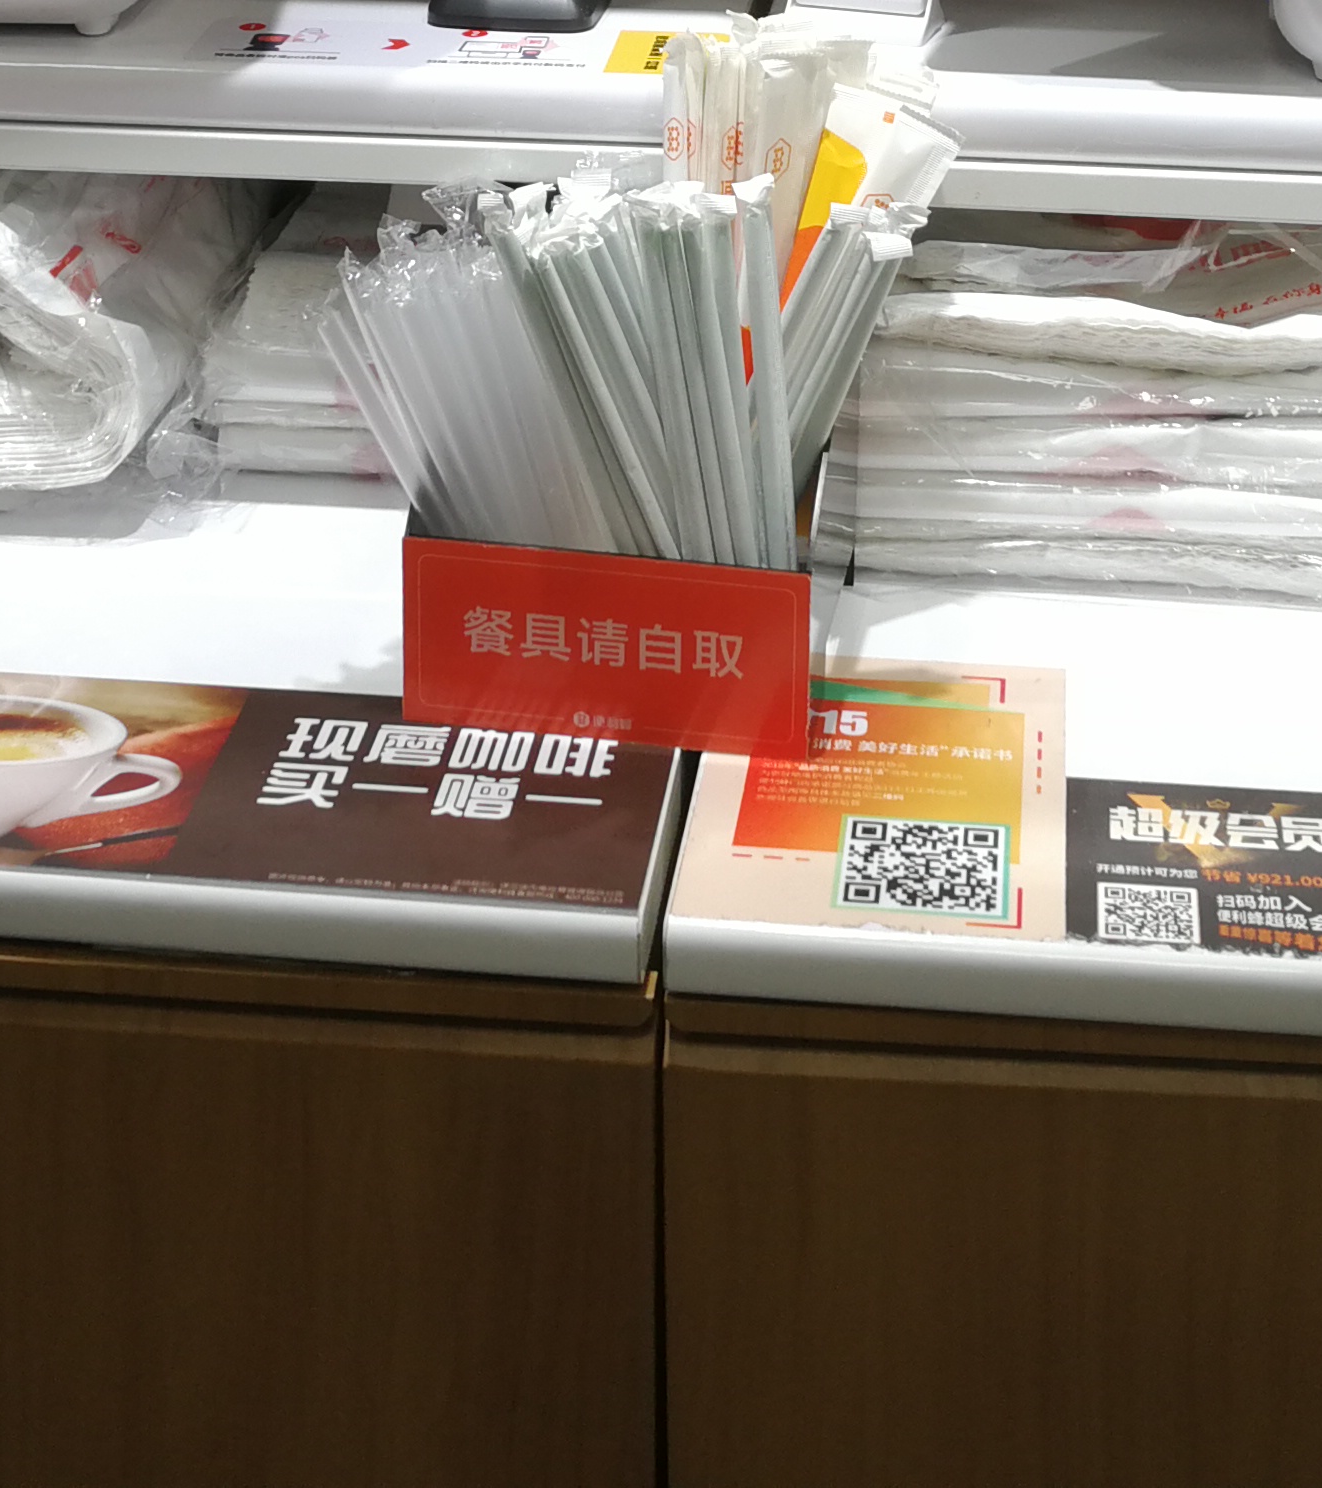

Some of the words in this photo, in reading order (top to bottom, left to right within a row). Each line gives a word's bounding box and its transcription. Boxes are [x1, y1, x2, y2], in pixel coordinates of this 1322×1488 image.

[462, 606, 744, 680] 餐具请自取
[810, 709, 869, 737] 15
[278, 717, 619, 778] 现磨咖啡
[256, 762, 604, 821] 买一赠一
[1201, 868, 1242, 884] 节省
[1216, 894, 1313, 913] 扫码加入
